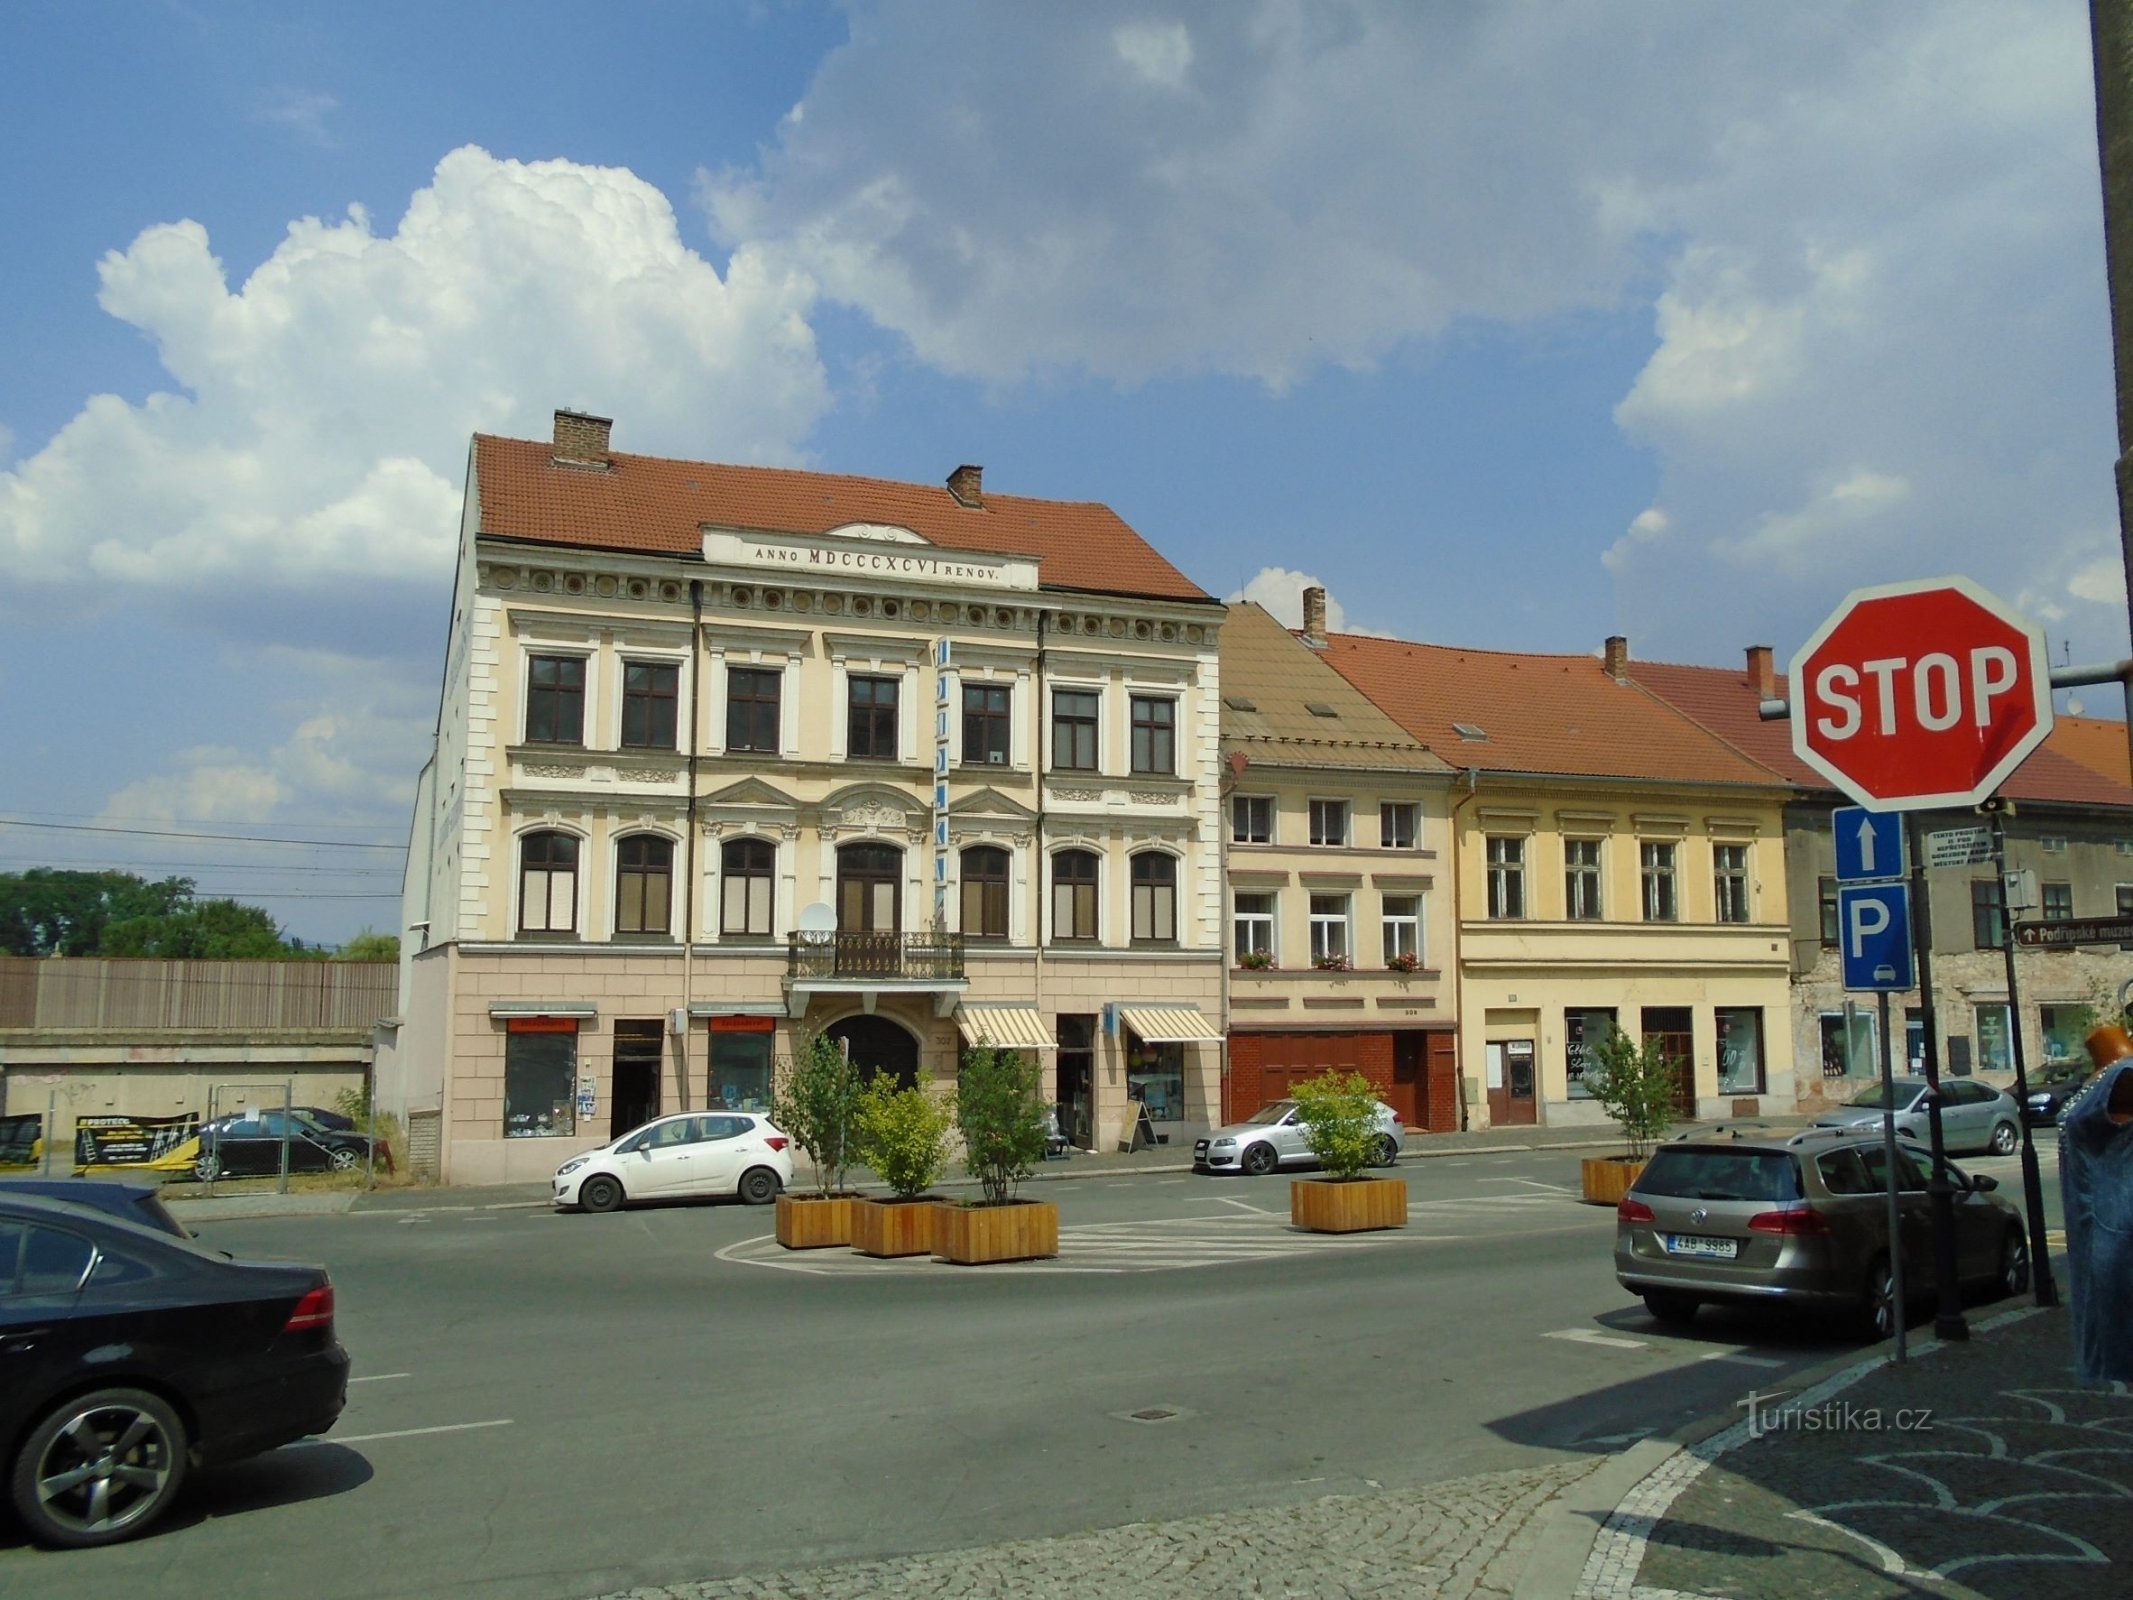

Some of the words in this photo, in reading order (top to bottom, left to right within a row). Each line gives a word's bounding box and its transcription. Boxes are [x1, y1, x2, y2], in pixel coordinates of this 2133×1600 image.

[756, 549, 798, 561] ANNO
[809, 549, 937, 574] MDCCCXCVI
[945, 566, 999, 580] RENOV.
[1816, 645, 2018, 741] STOP
[1850, 898, 1890, 959] P
[2039, 924, 2097, 944] Podřipské
[1677, 1237, 1697, 1249] 4AB
[1705, 1239, 1732, 1252] 9985
